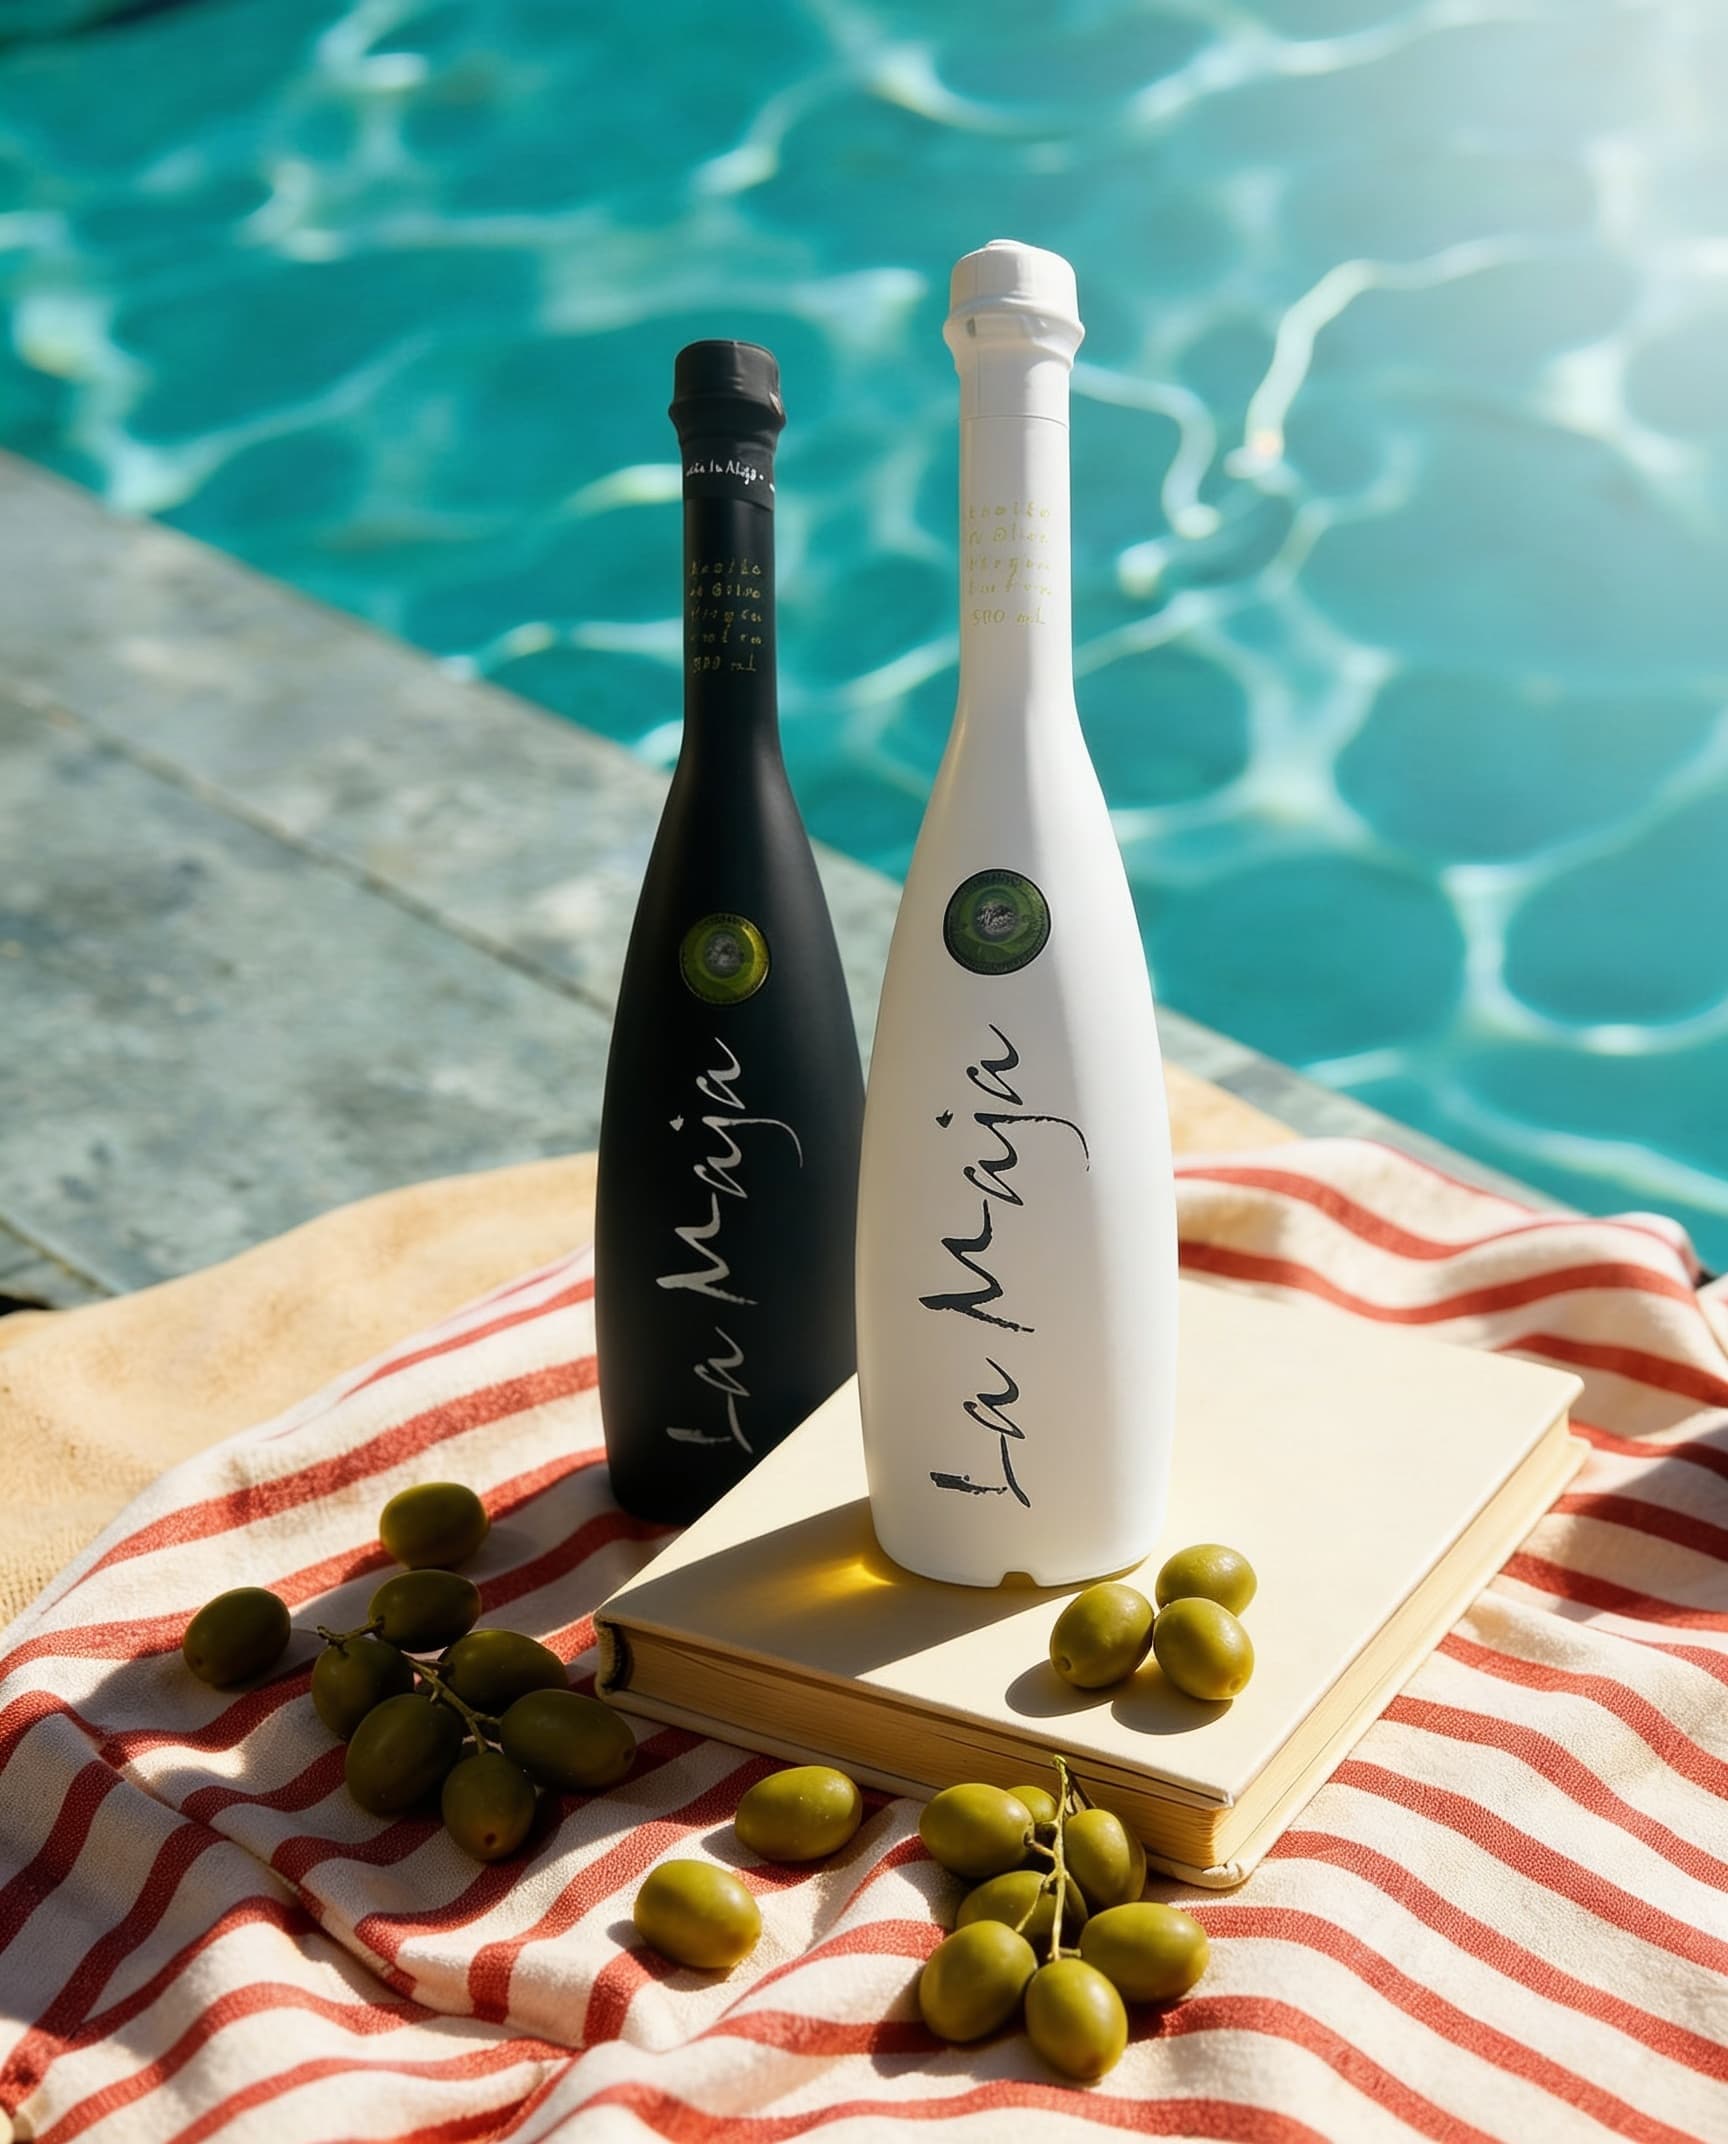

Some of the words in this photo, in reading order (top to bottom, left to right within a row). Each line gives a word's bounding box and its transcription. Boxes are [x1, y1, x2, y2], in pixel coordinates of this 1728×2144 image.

[655, 1037, 803, 1305] Maja
[918, 1023, 1091, 1335] Maja
[667, 1327, 753, 1454] La
[929, 1357, 1031, 1509] La
